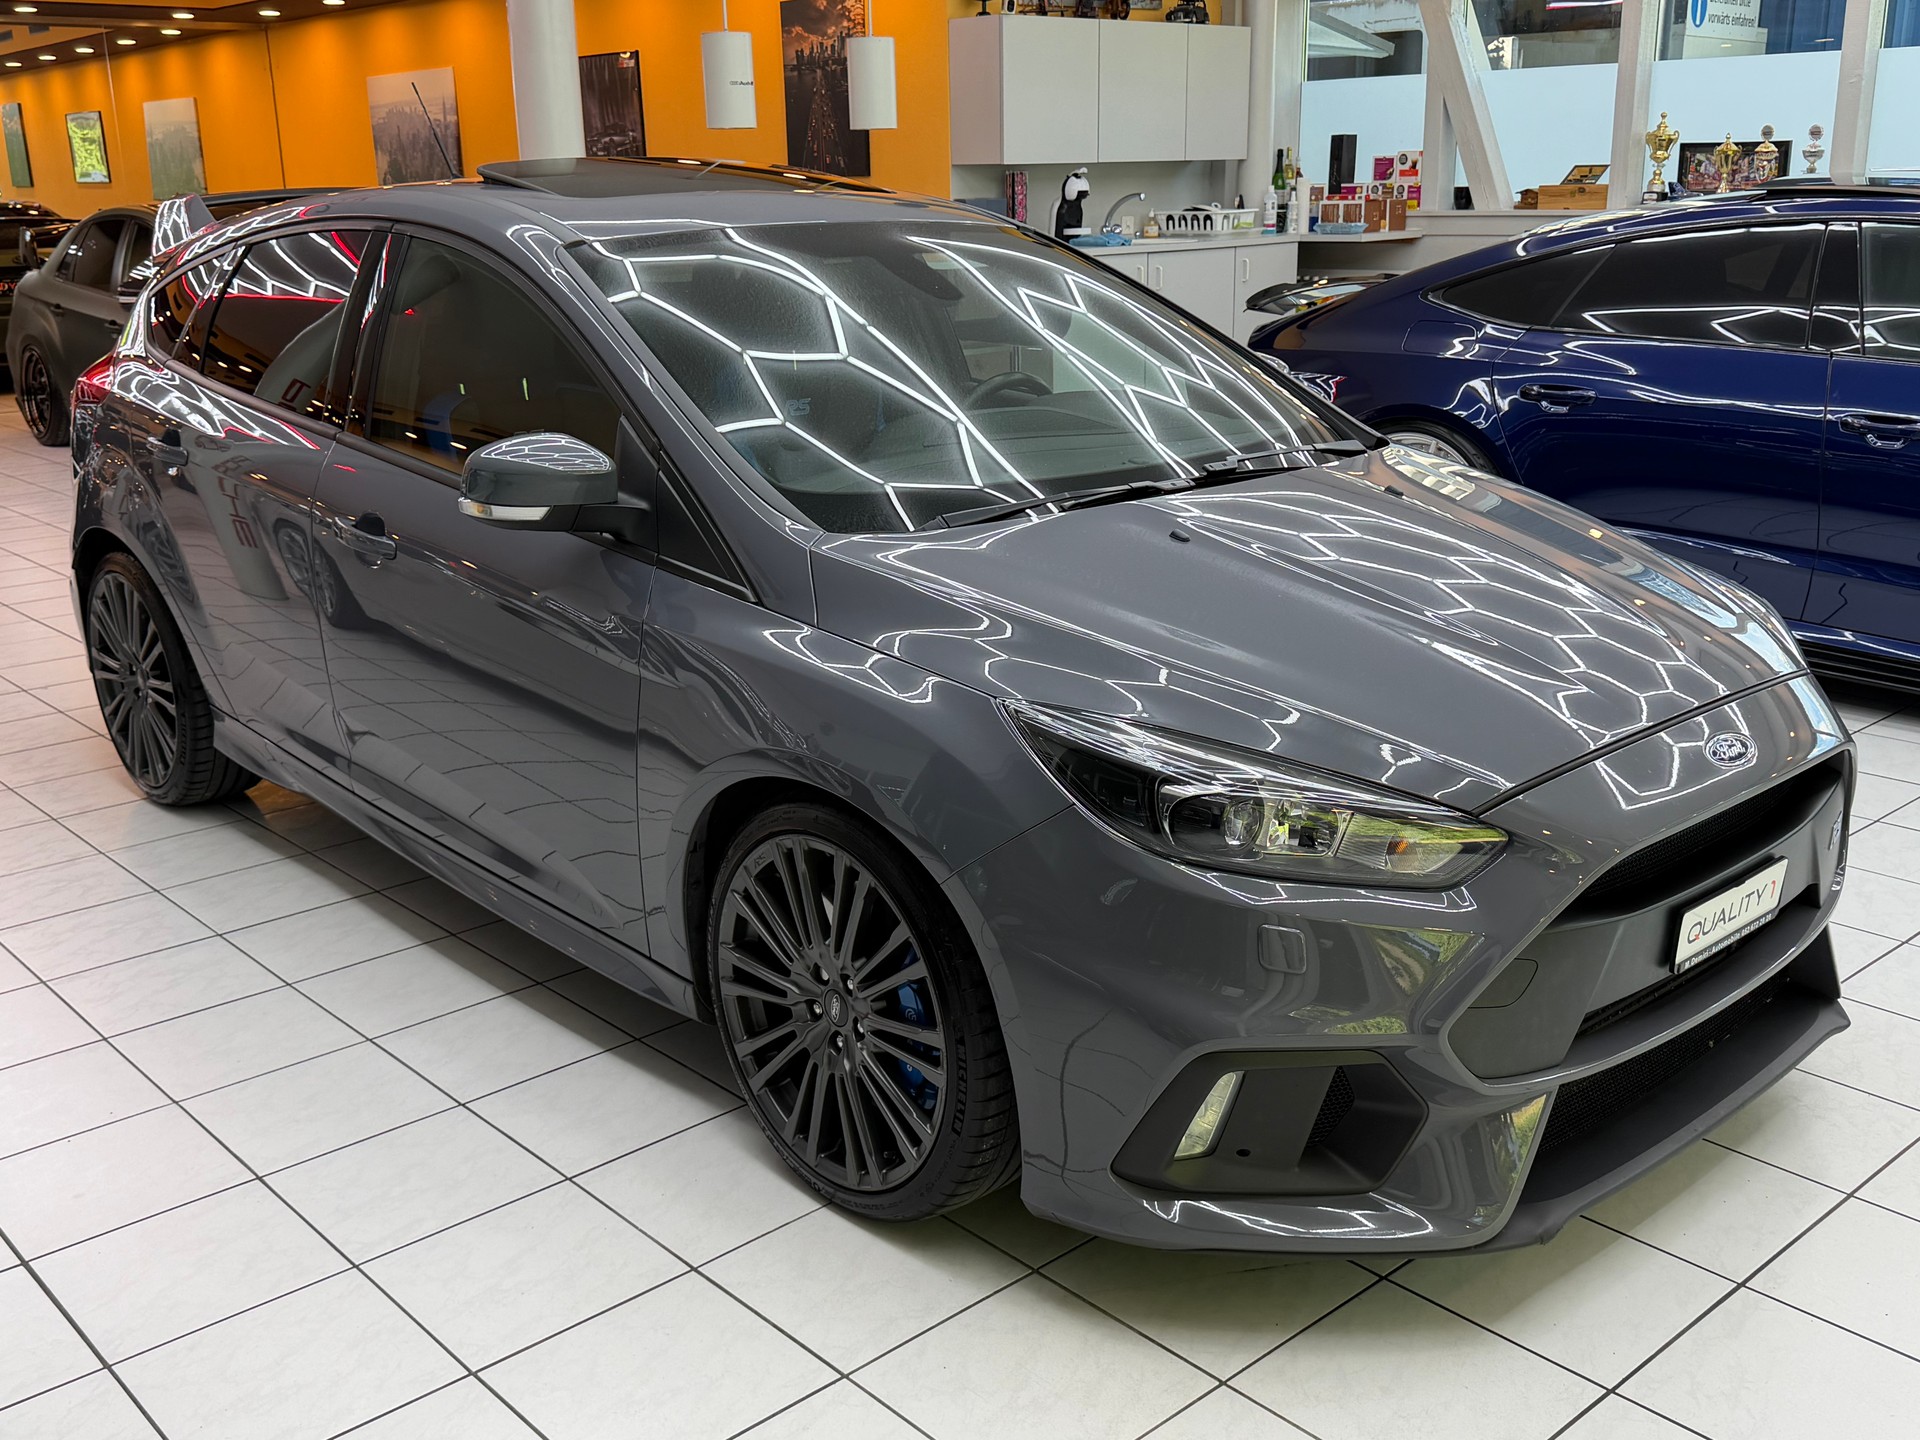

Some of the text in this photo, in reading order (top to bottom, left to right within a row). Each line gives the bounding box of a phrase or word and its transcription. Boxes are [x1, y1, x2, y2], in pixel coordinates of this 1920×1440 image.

[1708, 12, 1756, 27] vorwärts einfahren!
[1687, 884, 1768, 944] QUALITY
[952, 1038, 967, 1136] MICHELIN
